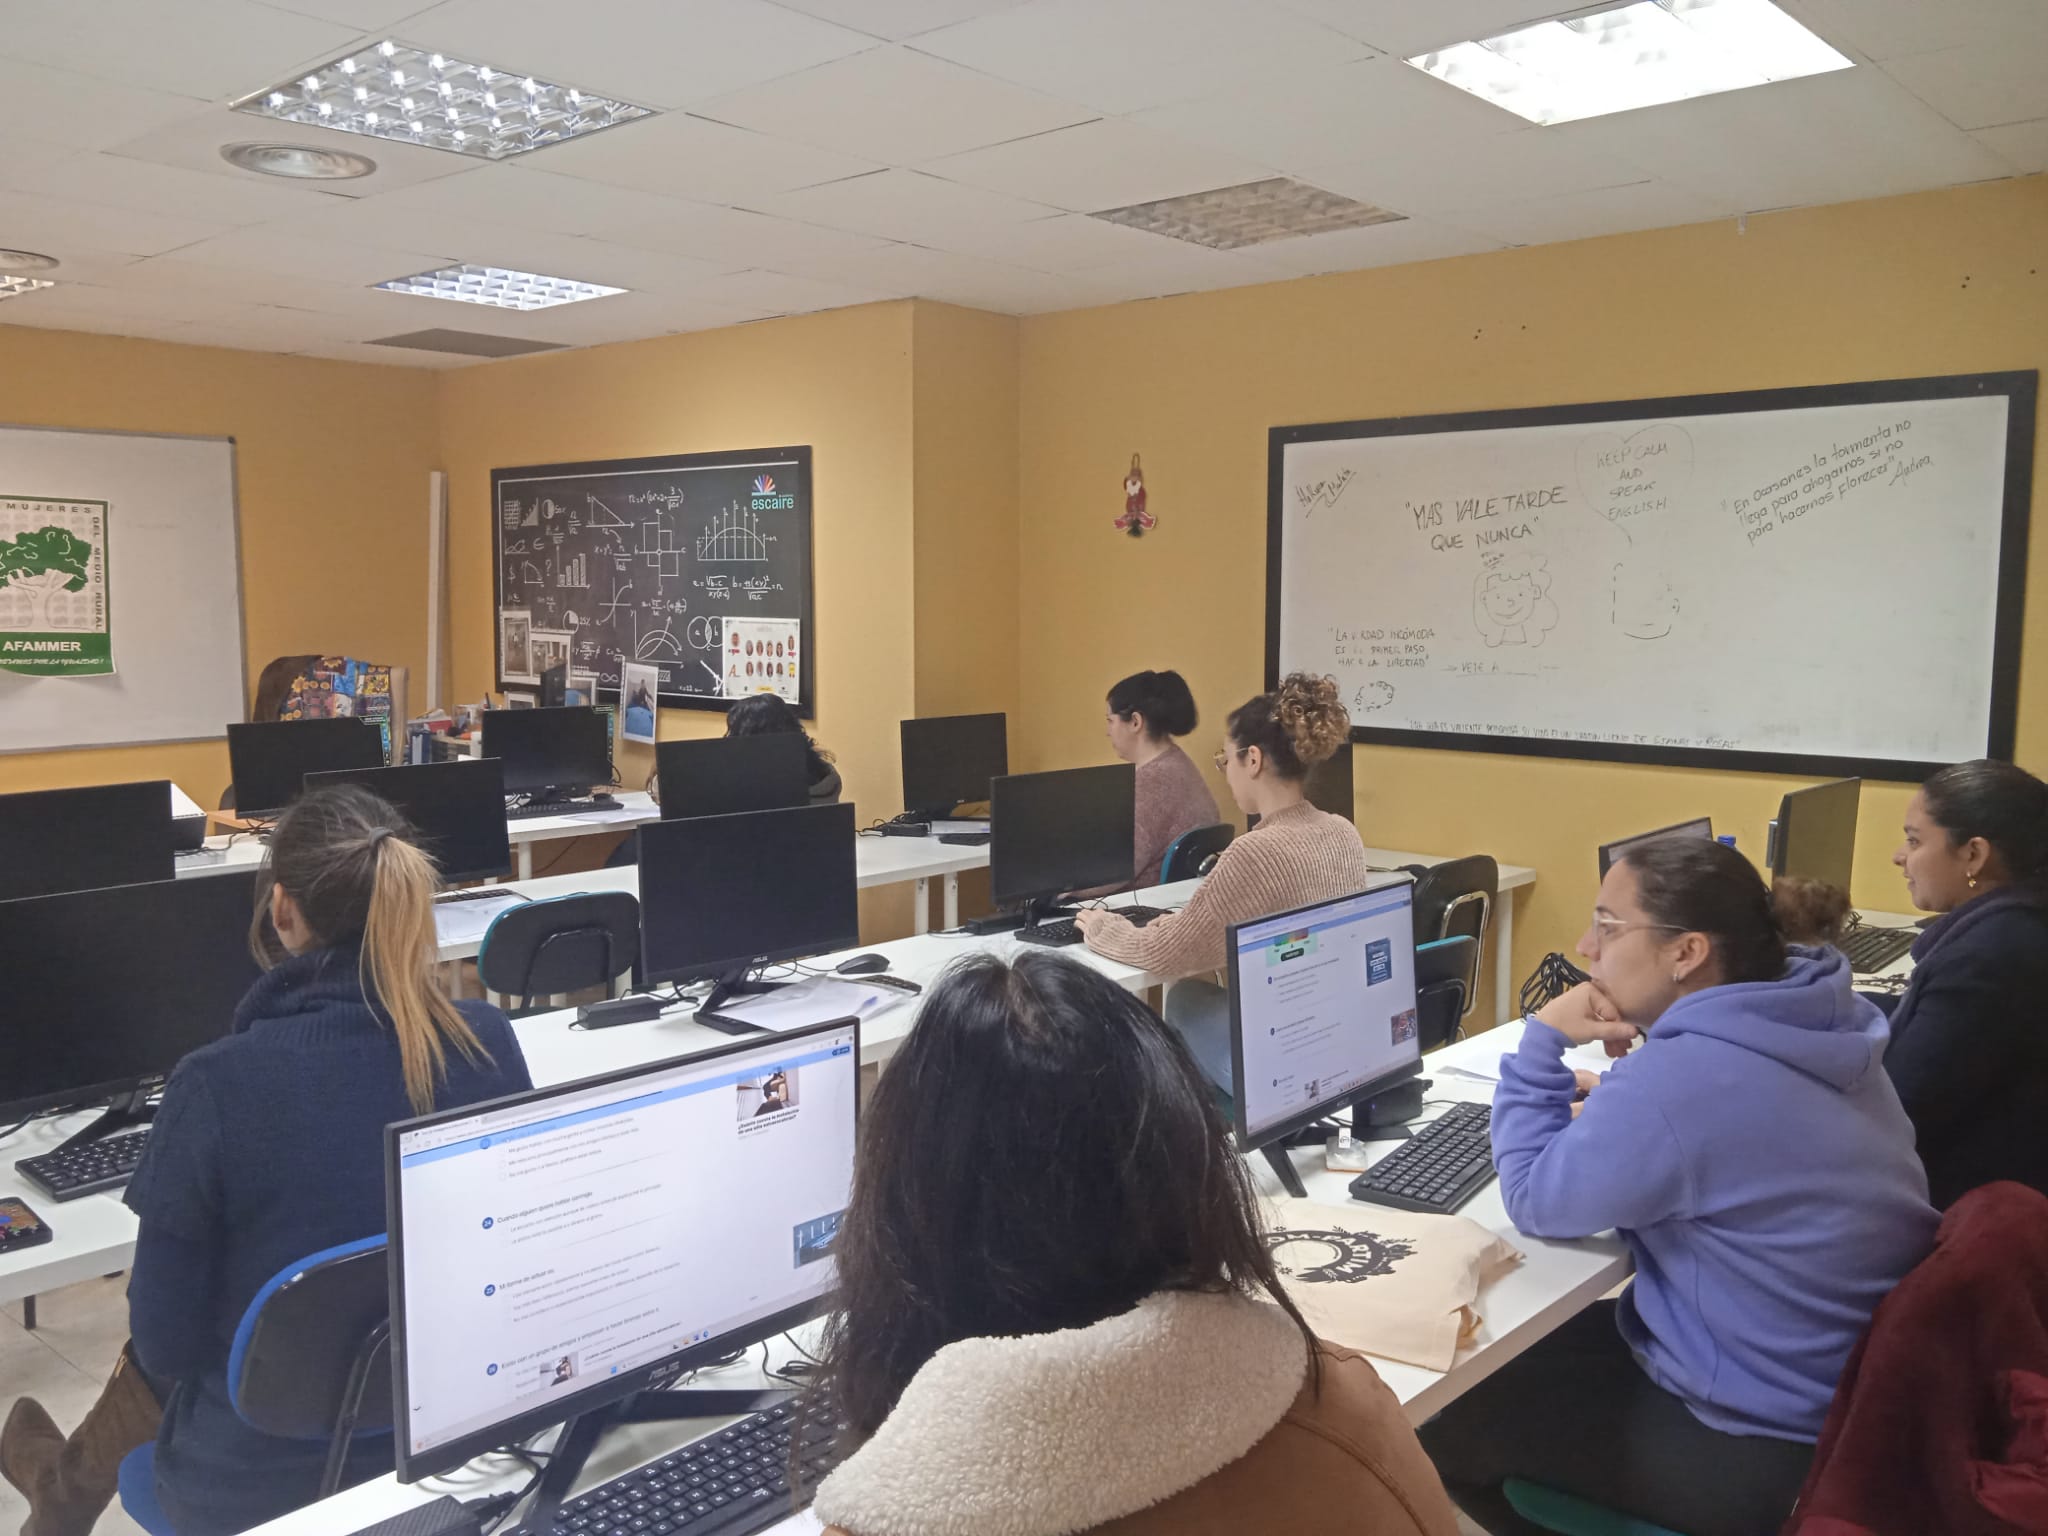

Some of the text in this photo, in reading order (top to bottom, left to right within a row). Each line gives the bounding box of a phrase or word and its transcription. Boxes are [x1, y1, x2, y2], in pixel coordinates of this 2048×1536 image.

[1895, 419, 1911, 433] no
[1772, 490, 1798, 515] para
[1802, 457, 1865, 494] ahogarnos
[1886, 439, 1904, 454] no
[6, 503, 92, 513] MUJERES
[751, 495, 794, 510] escaire
[1455, 497, 1499, 523] VALE
[1502, 486, 1568, 512] TARDE
[1608, 495, 1667, 521] ENGLISH
[92, 517, 100, 537] DEL
[1747, 522, 1773, 547] para
[1431, 534, 1464, 552] QUE
[3, 641, 82, 652] AFAMMER
[1404, 644, 1425, 655] PASO
[497, 1213, 518, 1224] Cuando
[648, 1360, 680, 1381] ASUS
